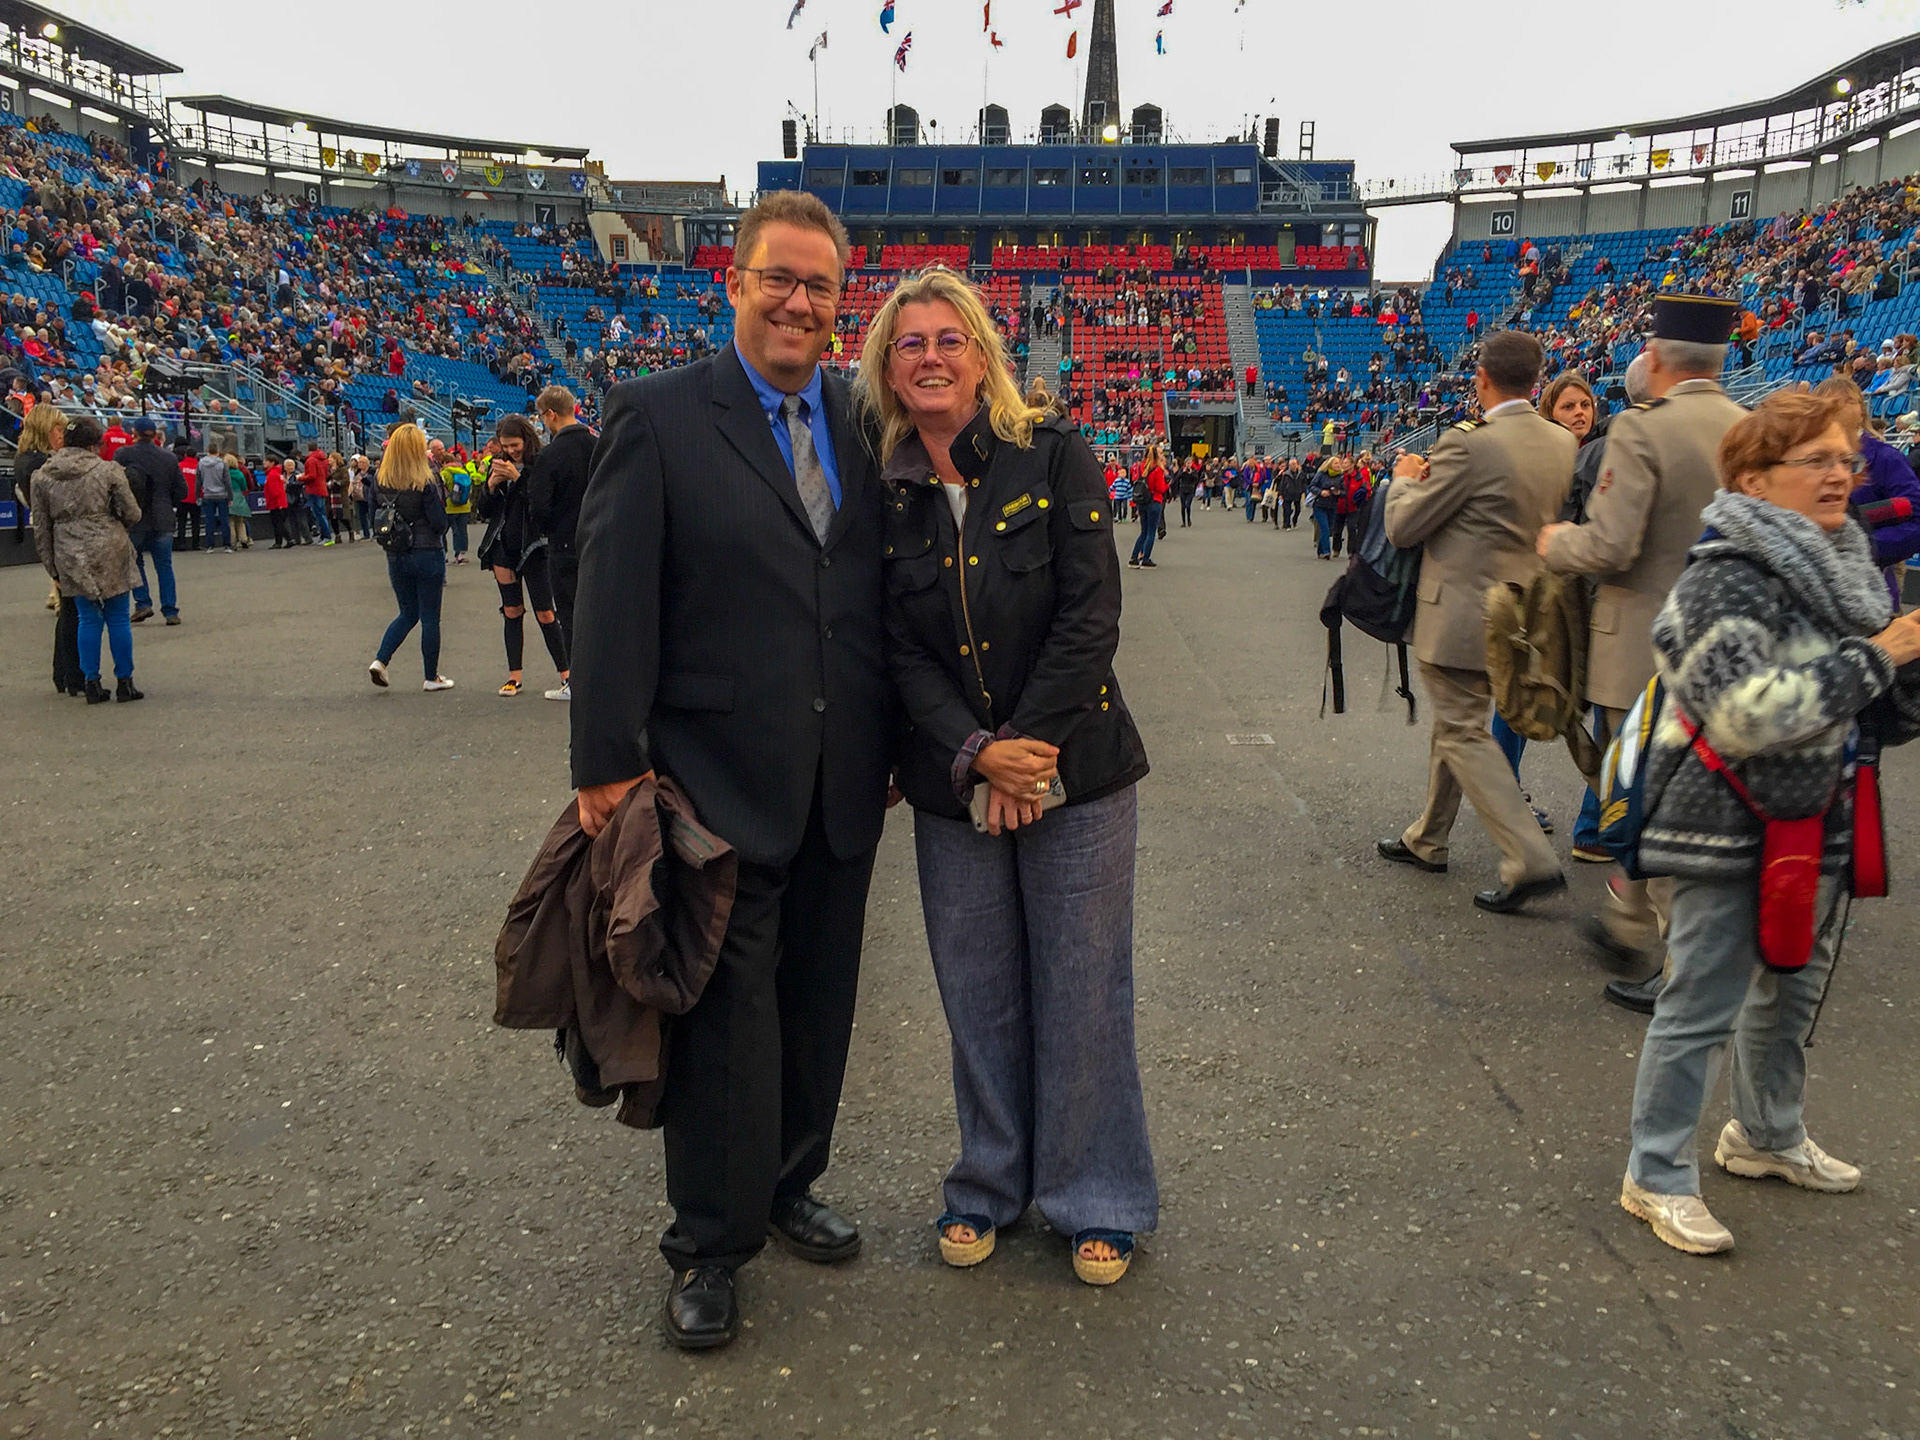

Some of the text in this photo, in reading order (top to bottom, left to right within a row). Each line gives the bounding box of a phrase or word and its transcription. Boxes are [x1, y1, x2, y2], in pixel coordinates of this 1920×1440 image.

[1, 90, 11, 111] 5
[308, 187, 318, 204] 6
[1735, 195, 1748, 214] 11
[540, 207, 551, 223] 7
[1494, 215, 1512, 231] 10
